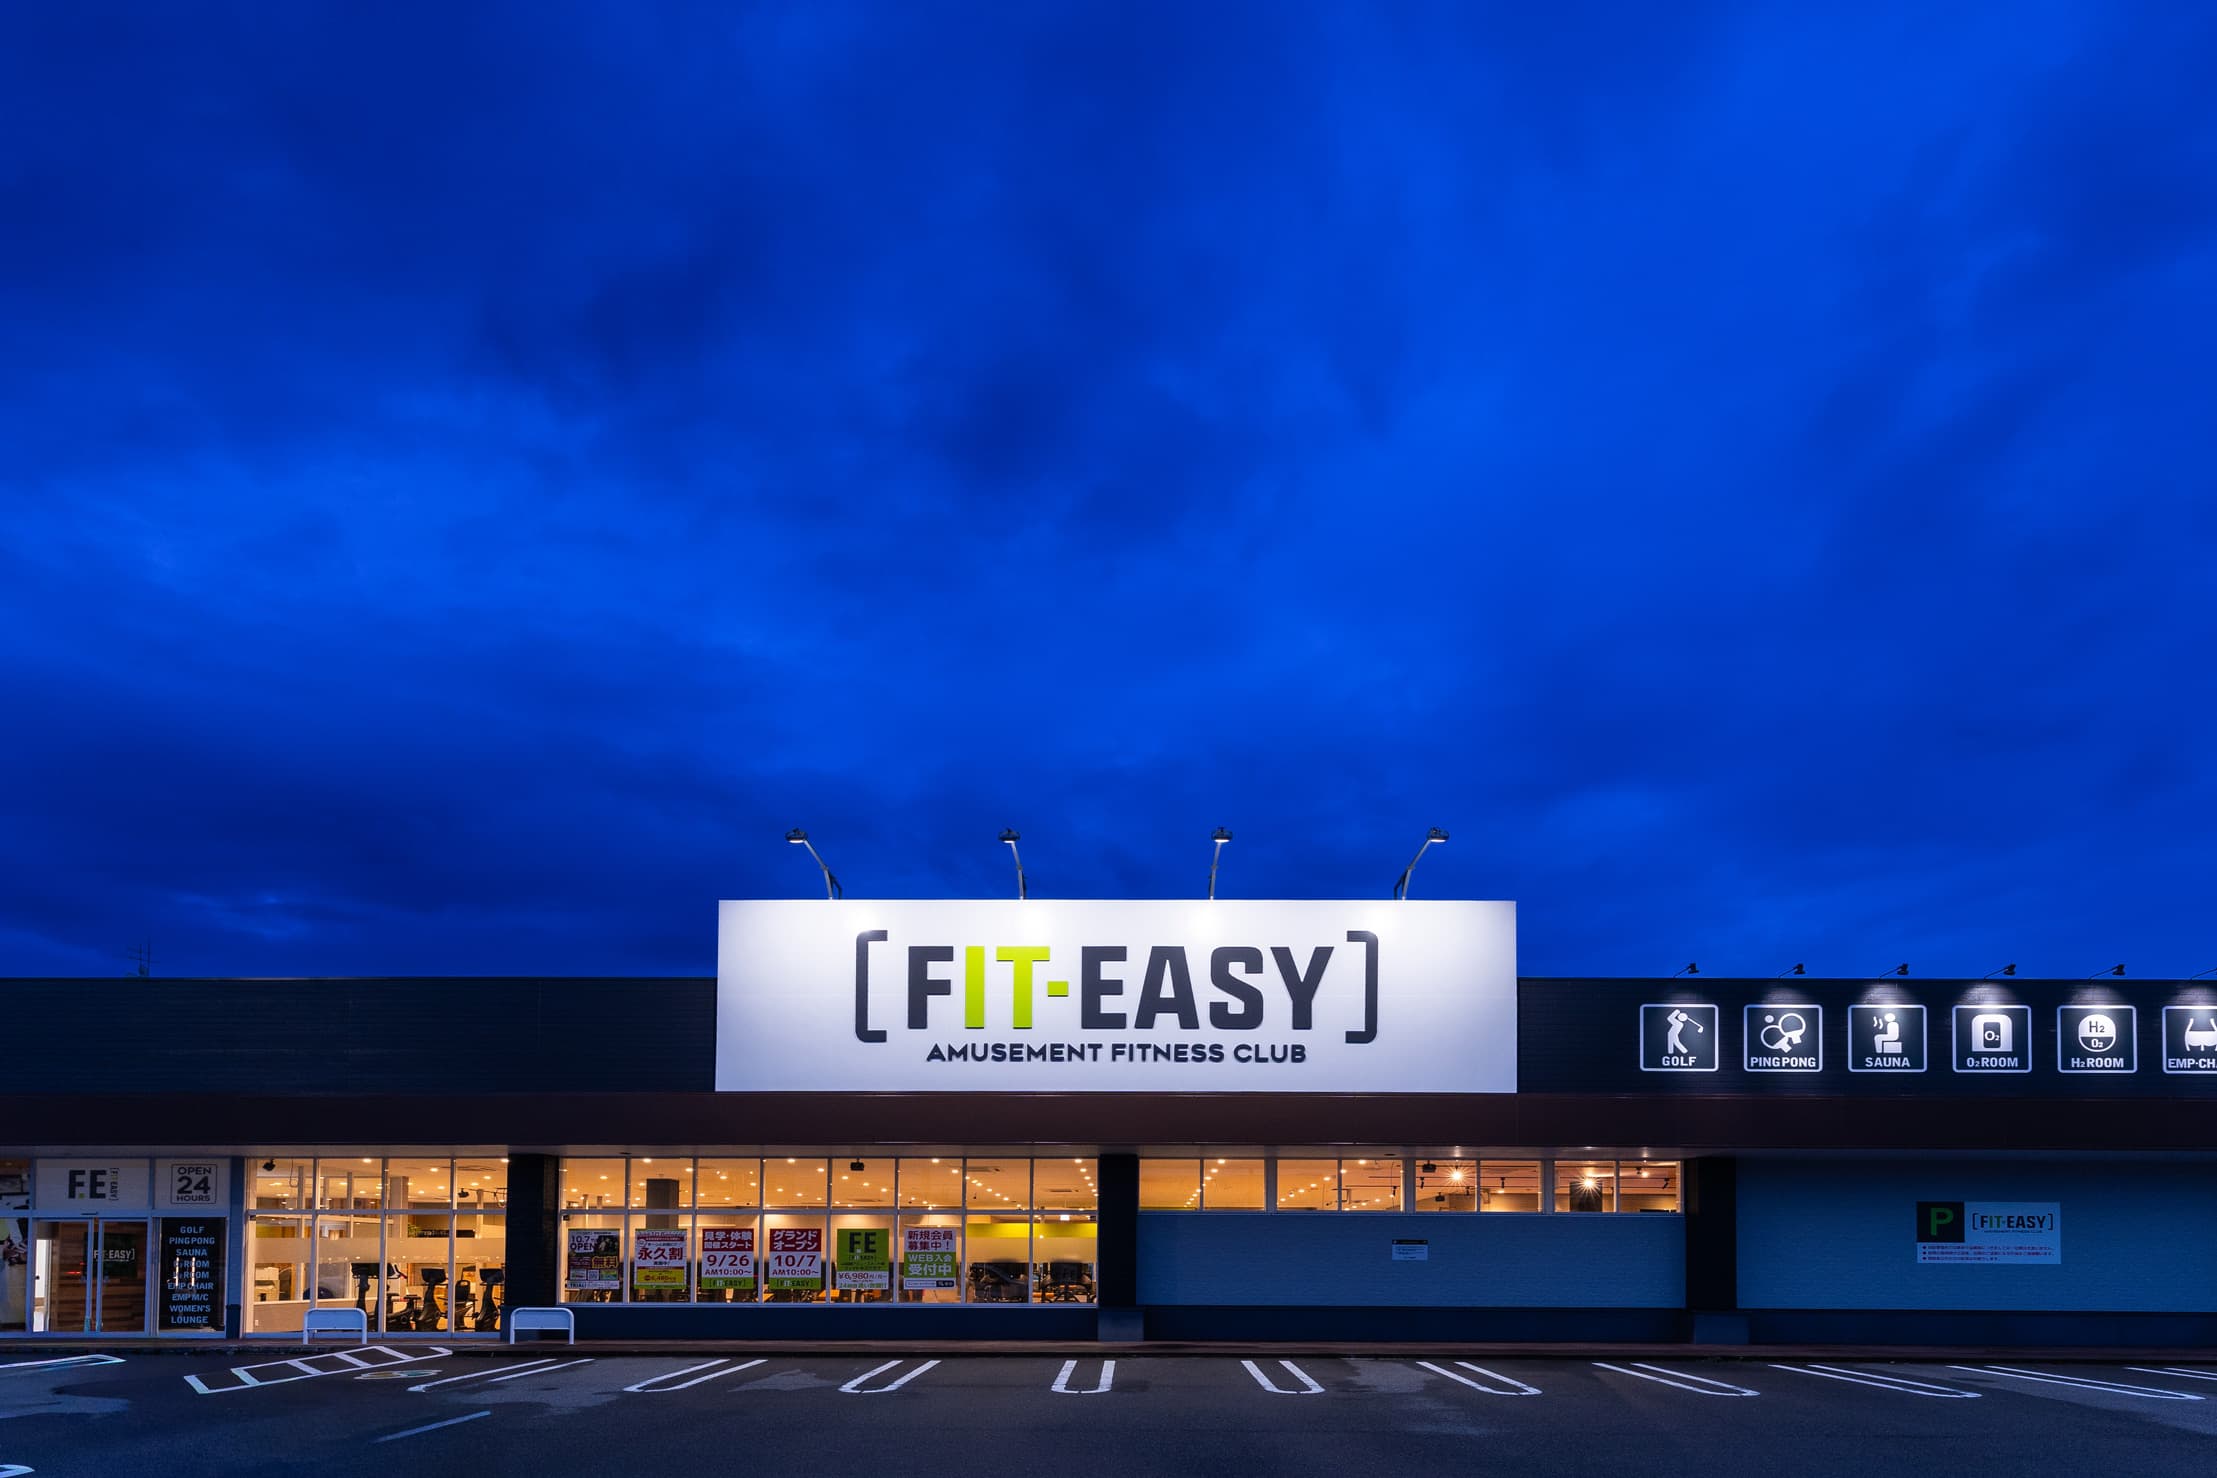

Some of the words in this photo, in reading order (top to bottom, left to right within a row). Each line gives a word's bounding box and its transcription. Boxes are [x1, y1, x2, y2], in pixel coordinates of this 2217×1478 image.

[926, 1043, 1103, 1063] AMUSEMENT
[1111, 1043, 1225, 1063] FITNESS
[1233, 1043, 1307, 1064] CLUB
[1661, 1056, 1697, 1067] GOLF
[1865, 1057, 1911, 1068] SAUNA
[177, 1167, 212, 1175] OPEN
[177, 1176, 211, 1194] 24
[1930, 1207, 1954, 1236] P
[180, 1226, 205, 1234] GOLF
[773, 1230, 818, 1240] グランド
[907, 1230, 953, 1240] 新規会員
[773, 1241, 817, 1250] オープン
[638, 1246, 683, 1260] 永久割
[707, 1254, 750, 1267] 9/26
[774, 1254, 817, 1267] 10/7
[908, 1263, 952, 1276] 受付中
[171, 1316, 209, 1324] LOUNGE
